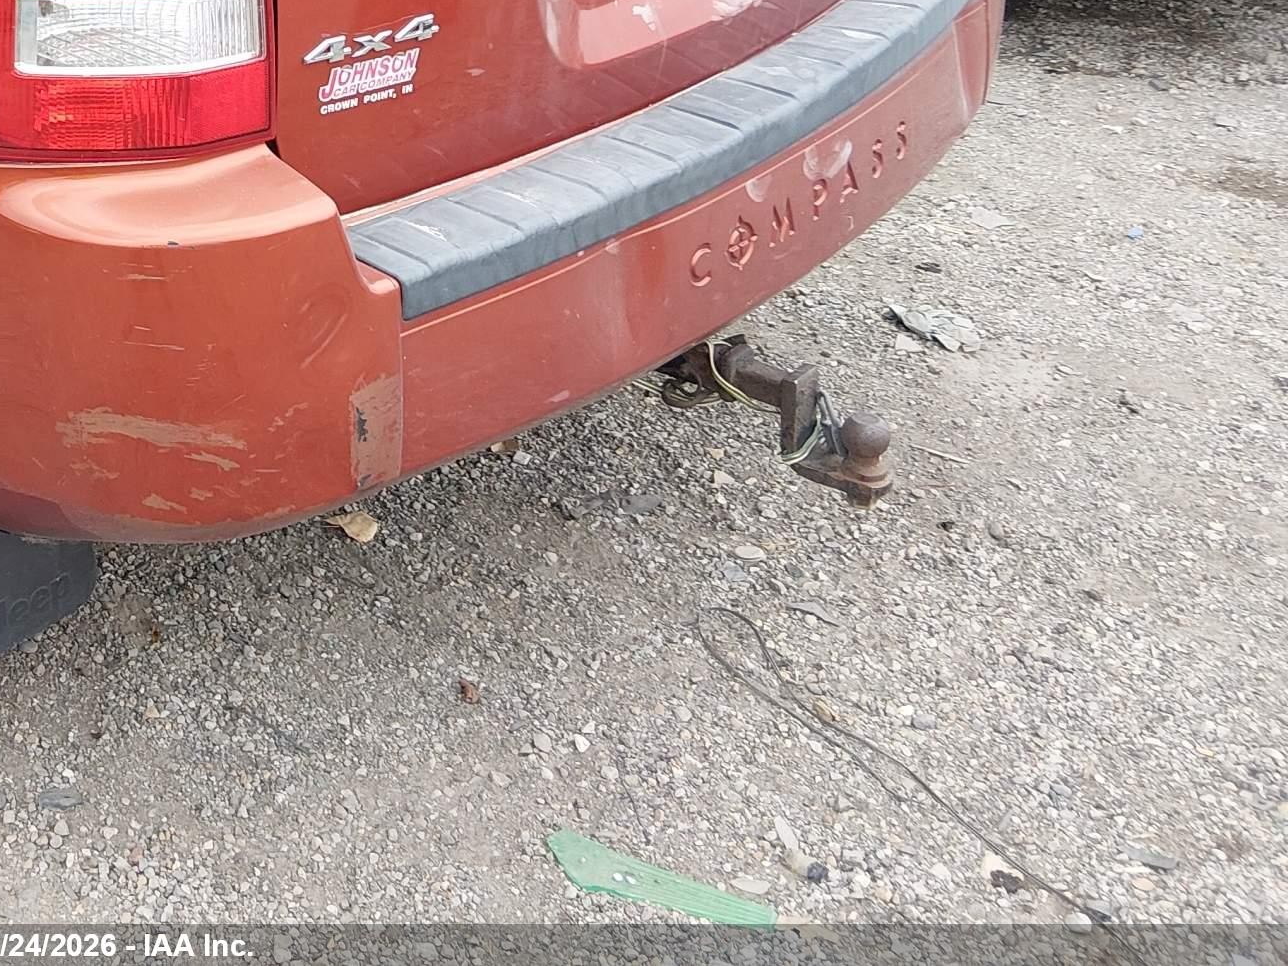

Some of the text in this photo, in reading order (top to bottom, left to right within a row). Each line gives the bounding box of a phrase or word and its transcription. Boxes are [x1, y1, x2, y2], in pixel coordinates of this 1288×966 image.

[320, 49, 419, 101] JOHNSON
[334, 70, 414, 97] CAR COMPANY
[320, 84, 413, 114] CROWN POINT, IN
[690, 120, 907, 287] COMPASS
